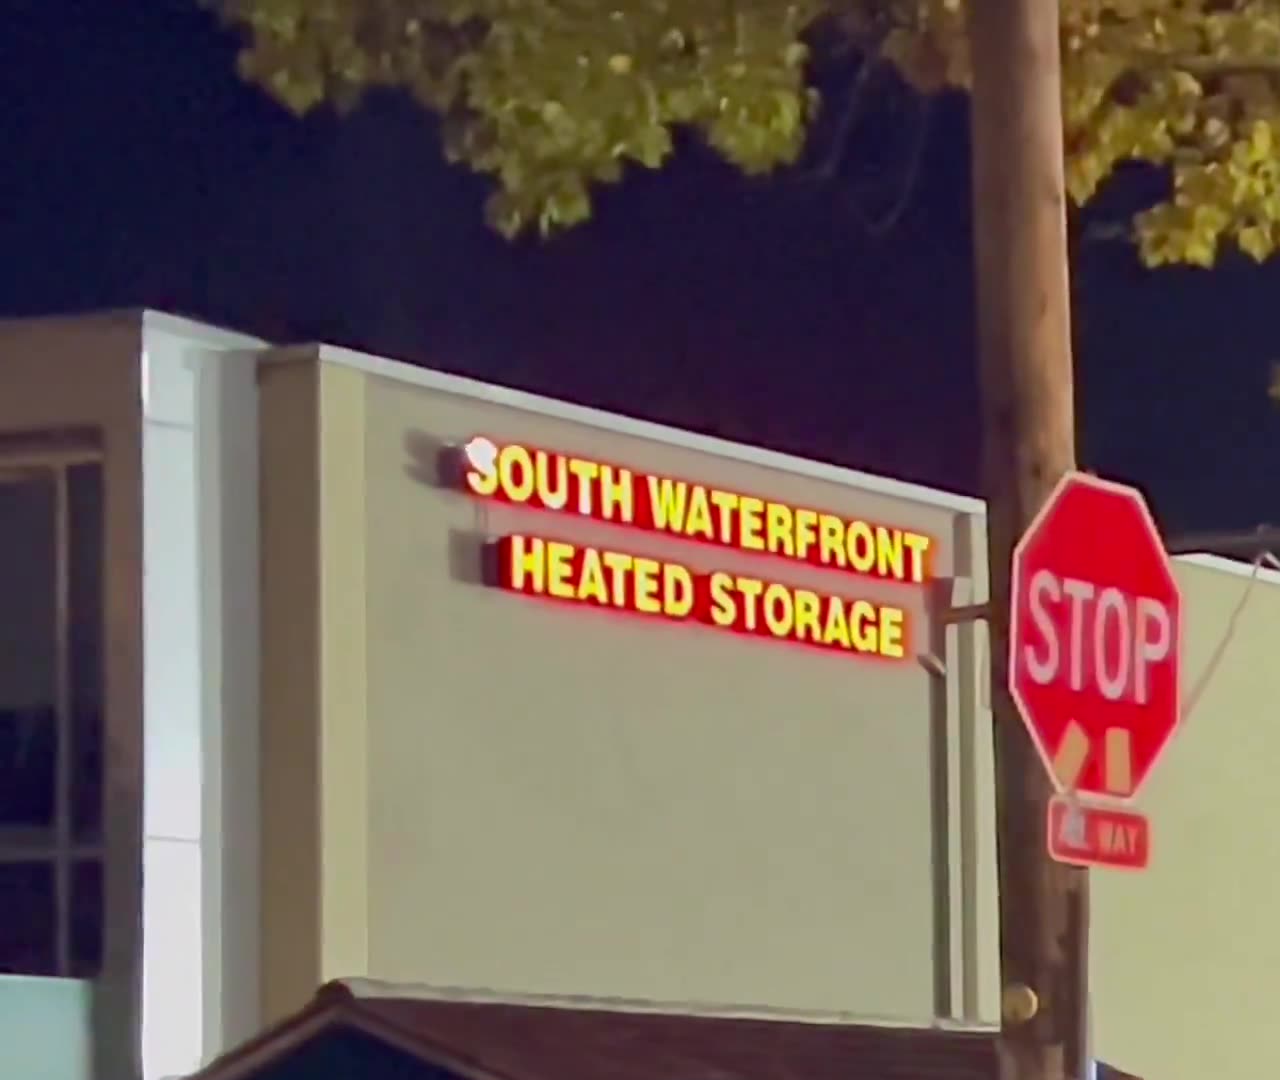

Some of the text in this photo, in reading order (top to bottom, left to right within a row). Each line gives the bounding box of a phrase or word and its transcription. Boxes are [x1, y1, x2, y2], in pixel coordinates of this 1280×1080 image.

[466, 437, 930, 583] SOUTH WATERFRONT
[510, 535, 905, 658] HEATED STORAGE
[1024, 568, 1170, 705] STOP
